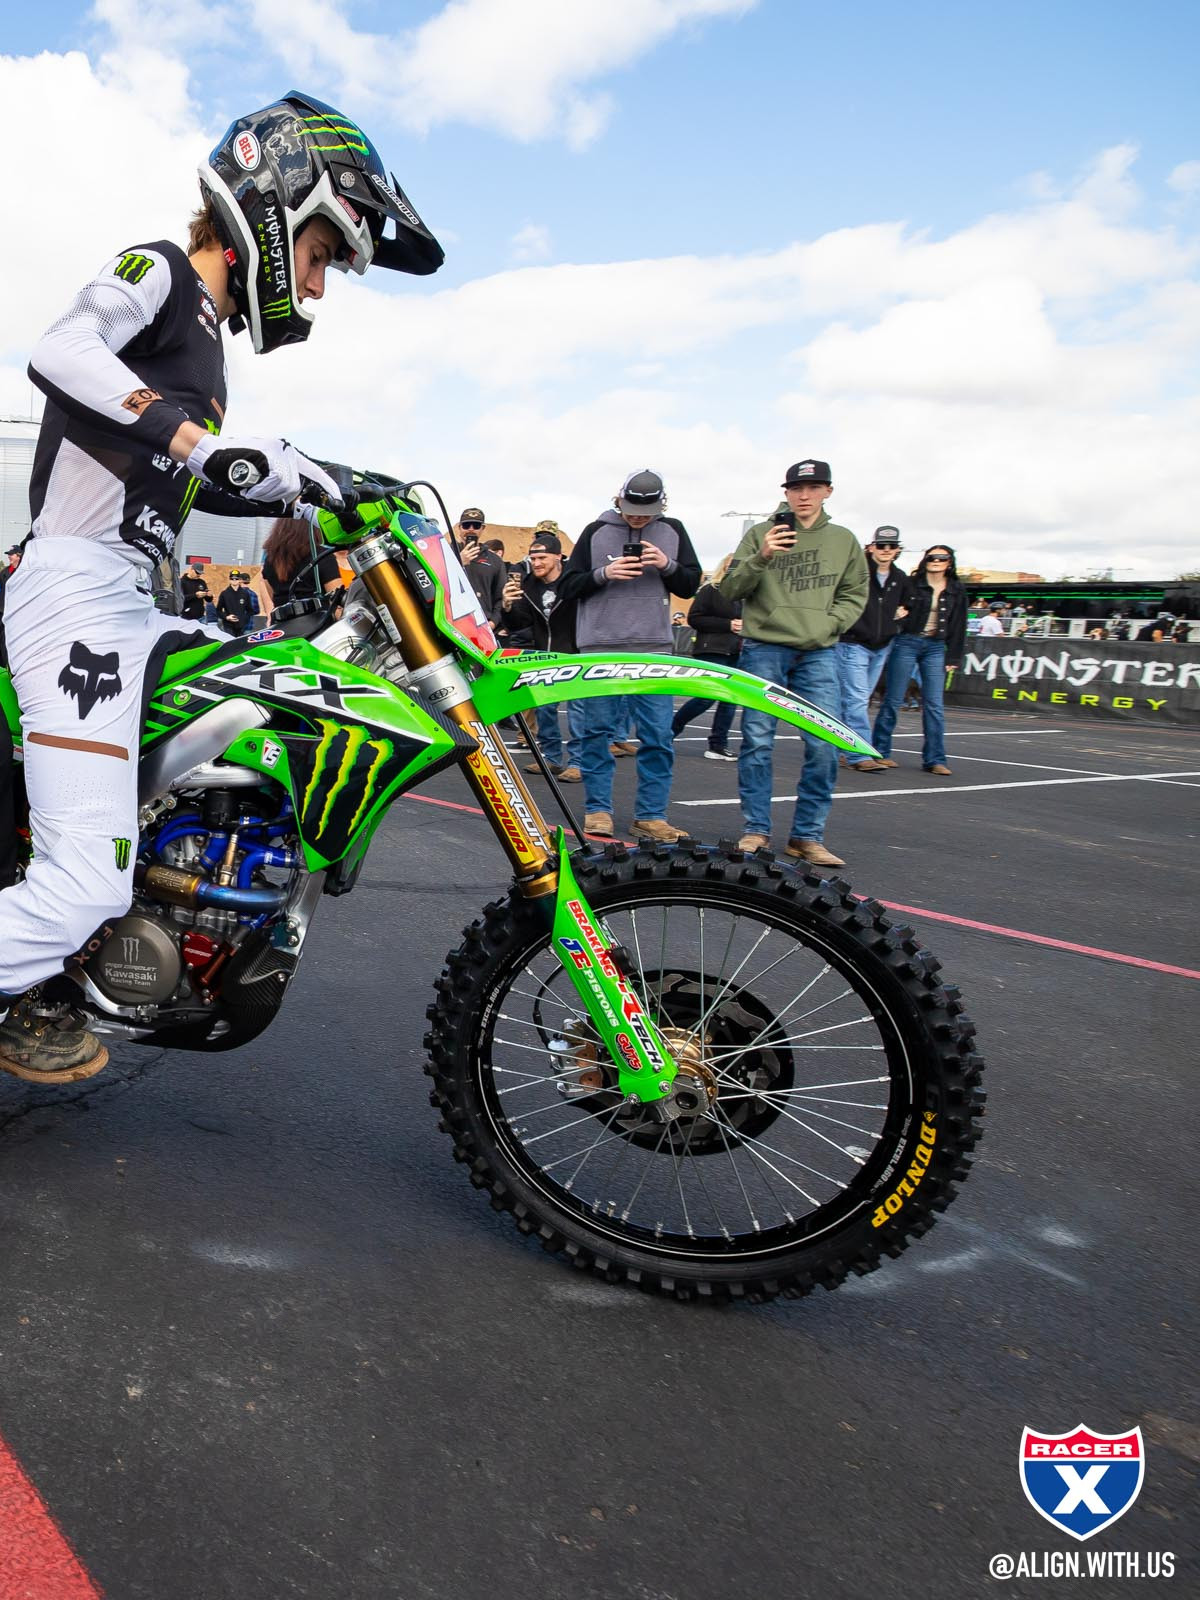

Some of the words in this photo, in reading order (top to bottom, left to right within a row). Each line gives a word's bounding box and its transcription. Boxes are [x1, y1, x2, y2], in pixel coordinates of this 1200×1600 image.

[237, 135, 256, 166] BELL
[257, 223, 272, 283] ENERGY
[265, 206, 288, 294] MONSTER
[415, 570, 431, 587] 247
[495, 654, 558, 665] KITCHEN
[510, 664, 582, 691] PRO
[583, 663, 734, 681] CIRCUIT
[963, 649, 1200, 688] MONSTER
[992, 688, 1168, 711] ENERGY
[469, 721, 500, 767] PRO
[496, 768, 548, 851] CIRCUIT
[478, 775, 529, 853] SHOWA
[567, 899, 618, 978] BRAKING
[105, 968, 157, 981] Kawasaki
[134, 979, 151, 987] Team
[559, 937, 593, 969] JE
[583, 968, 619, 1028] PISTONS
[616, 1033, 642, 1071] GUTS
[872, 1121, 937, 1228] DUNLOP
